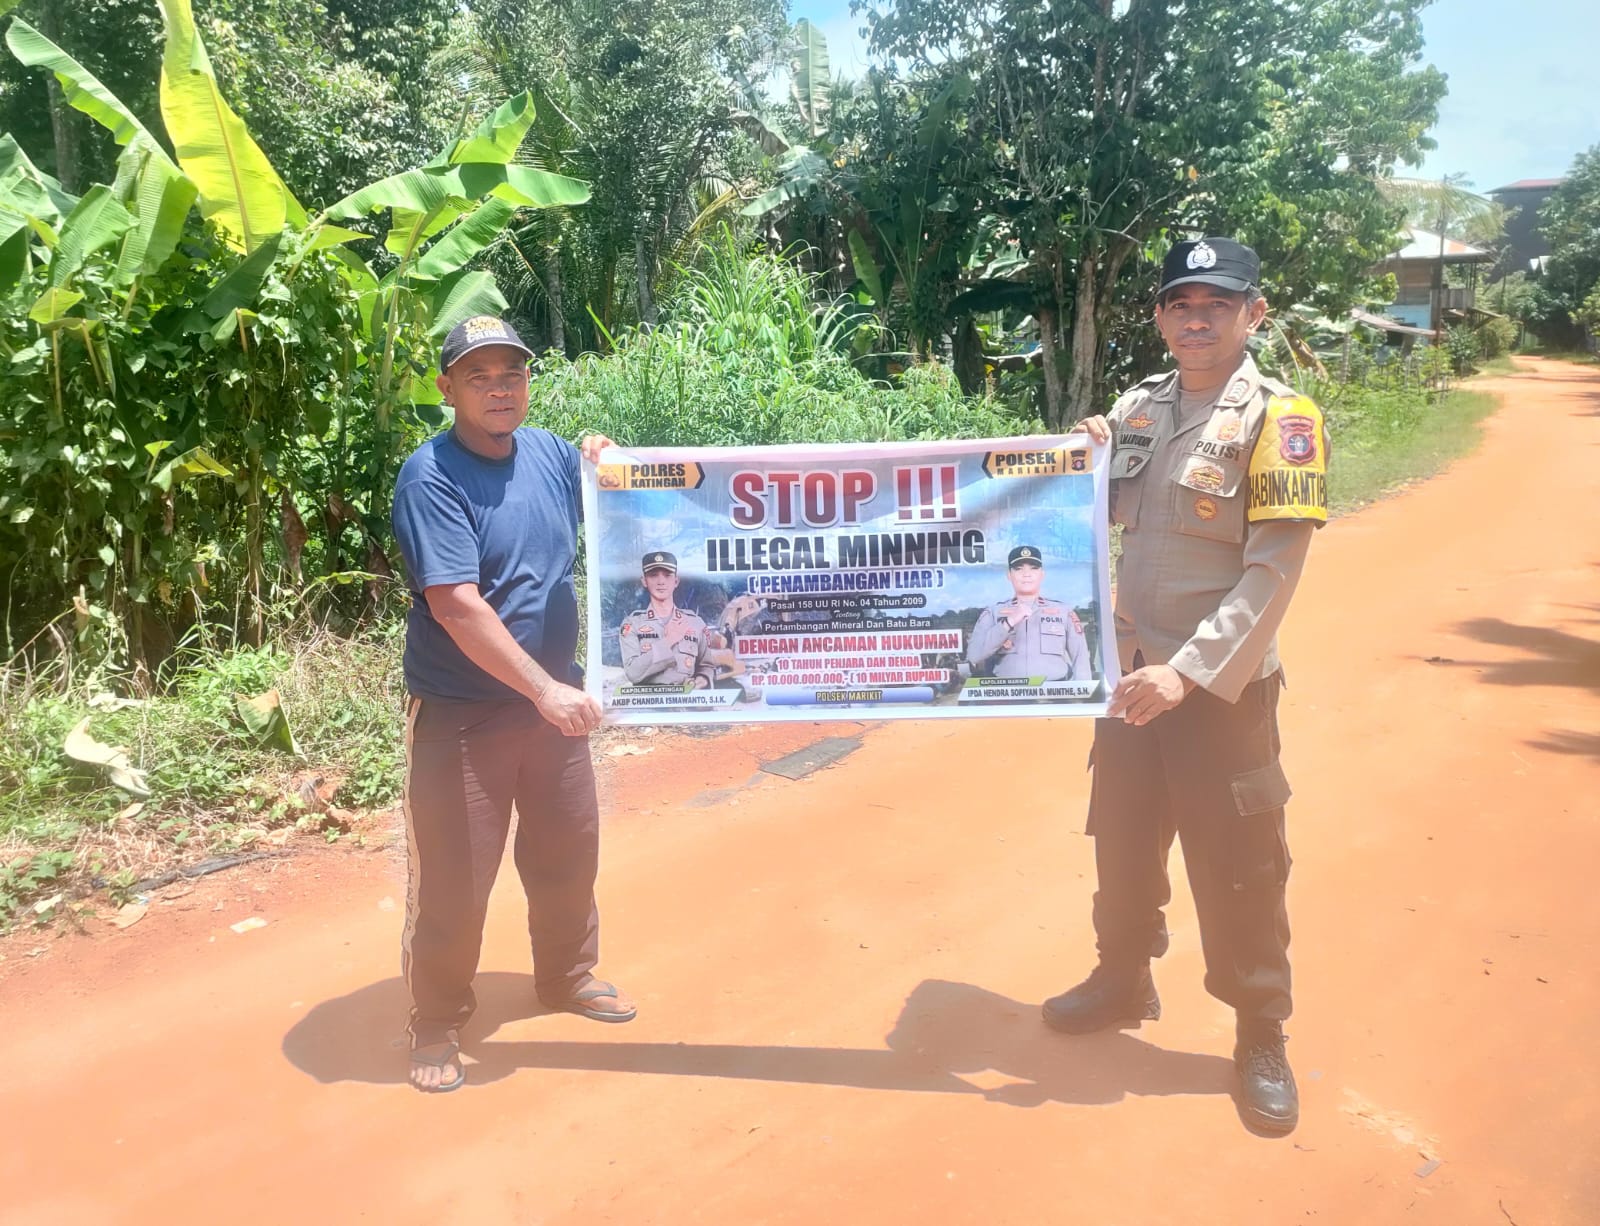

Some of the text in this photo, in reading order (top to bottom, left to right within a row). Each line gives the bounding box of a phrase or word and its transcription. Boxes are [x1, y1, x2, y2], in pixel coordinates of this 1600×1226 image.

[1194, 440, 1240, 461] POLISI
[995, 452, 1057, 467] POLSEK
[631, 464, 686, 477] POLRES
[997, 466, 1056, 475] MARIKIT
[631, 478, 686, 489] KATINGAN
[730, 466, 957, 526] STOP !!!
[706, 530, 985, 572] ILLEGAL MINNING
[770, 601, 795, 610] Pasal
[799, 600, 813, 608] 158
[815, 600, 829, 608] UU
[842, 599, 858, 607] No.
[860, 599, 871, 607] 04
[873, 598, 900, 606] Tahun
[902, 597, 924, 605] 2009
[765, 619, 931, 632] Pertambangan Mineral Dan Batu Bara
[738, 633, 959, 655] DENGAN ANCAMAN HUKUMAN
[778, 656, 920, 670] 10 TAHUN PENJARA DAN DENDA
[856, 672, 867, 683] 10
[869, 671, 904, 683] MILYAR
[816, 690, 882, 702] POLSEK MARIKIT
[983, 689, 1010, 697] HENDRA
[611, 698, 631, 706] AKBP
[631, 697, 664, 705] CHANDRA
[665, 696, 708, 705] ISMAWANTO,
